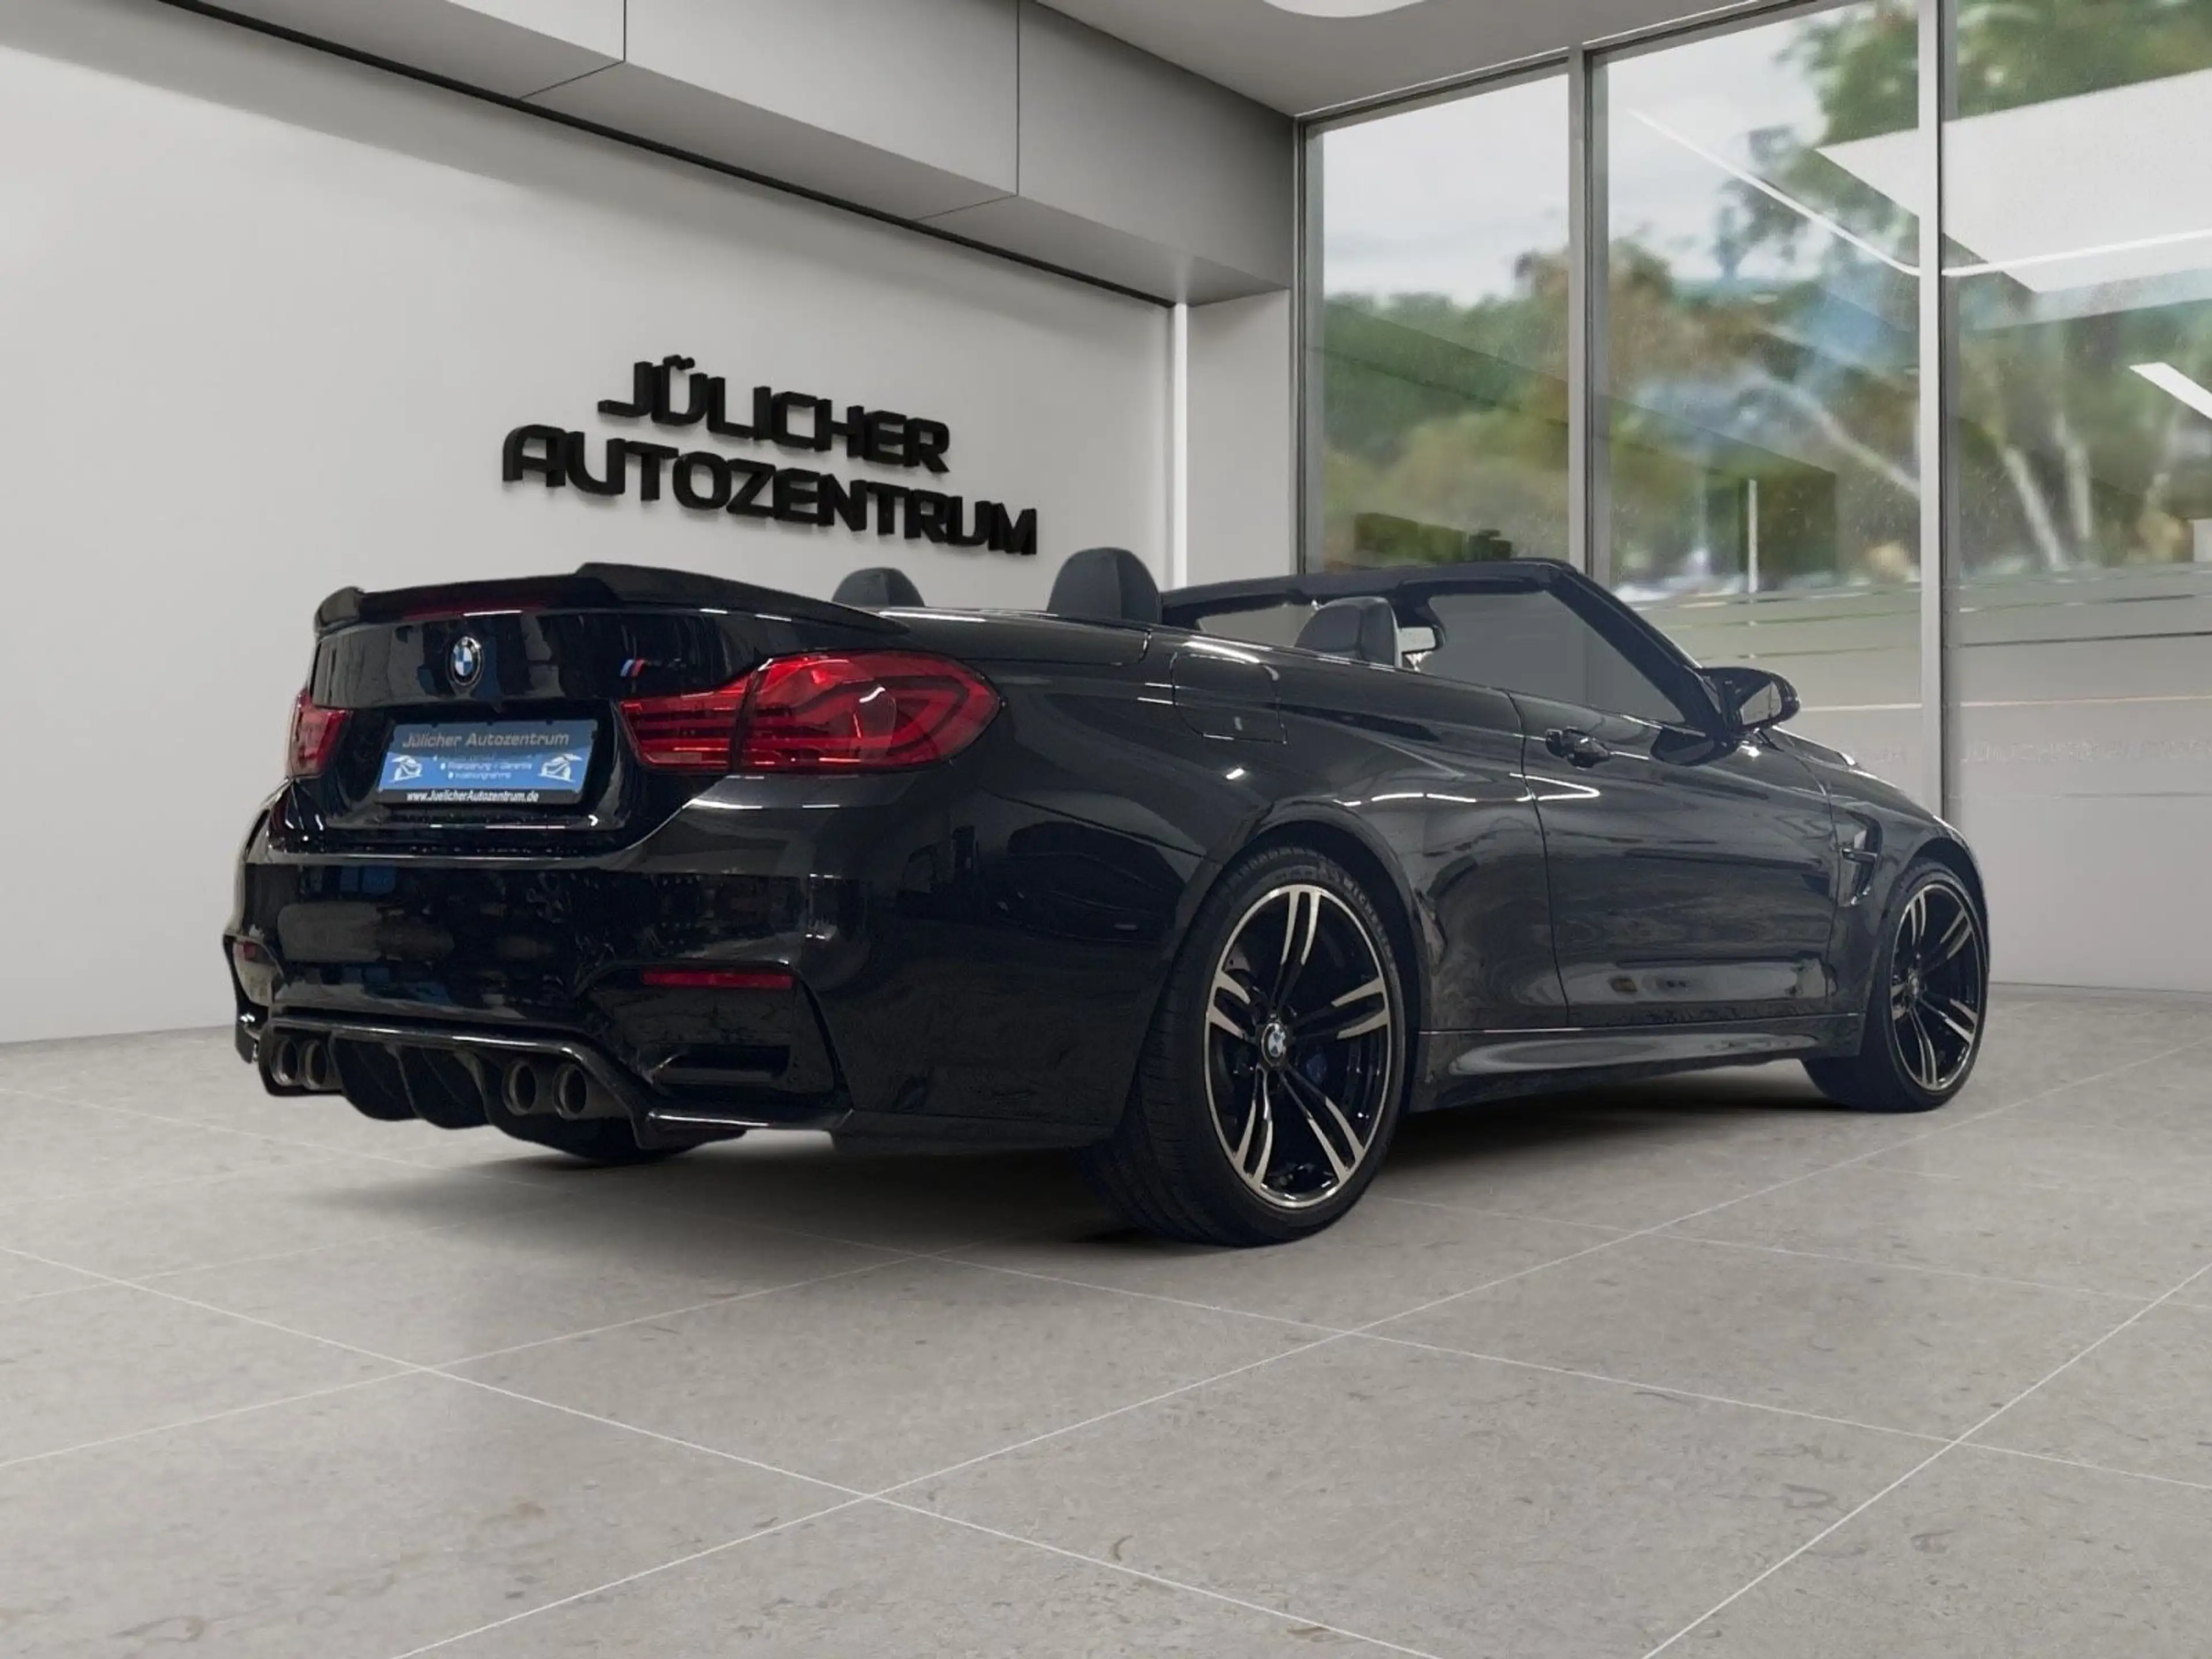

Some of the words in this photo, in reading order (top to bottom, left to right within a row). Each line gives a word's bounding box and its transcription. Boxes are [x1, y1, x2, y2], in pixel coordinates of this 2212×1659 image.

[598, 355, 949, 474] JÜLICHER
[503, 425, 1037, 556] AUTOZENTRUM
[465, 732, 569, 747] Autozentrum
